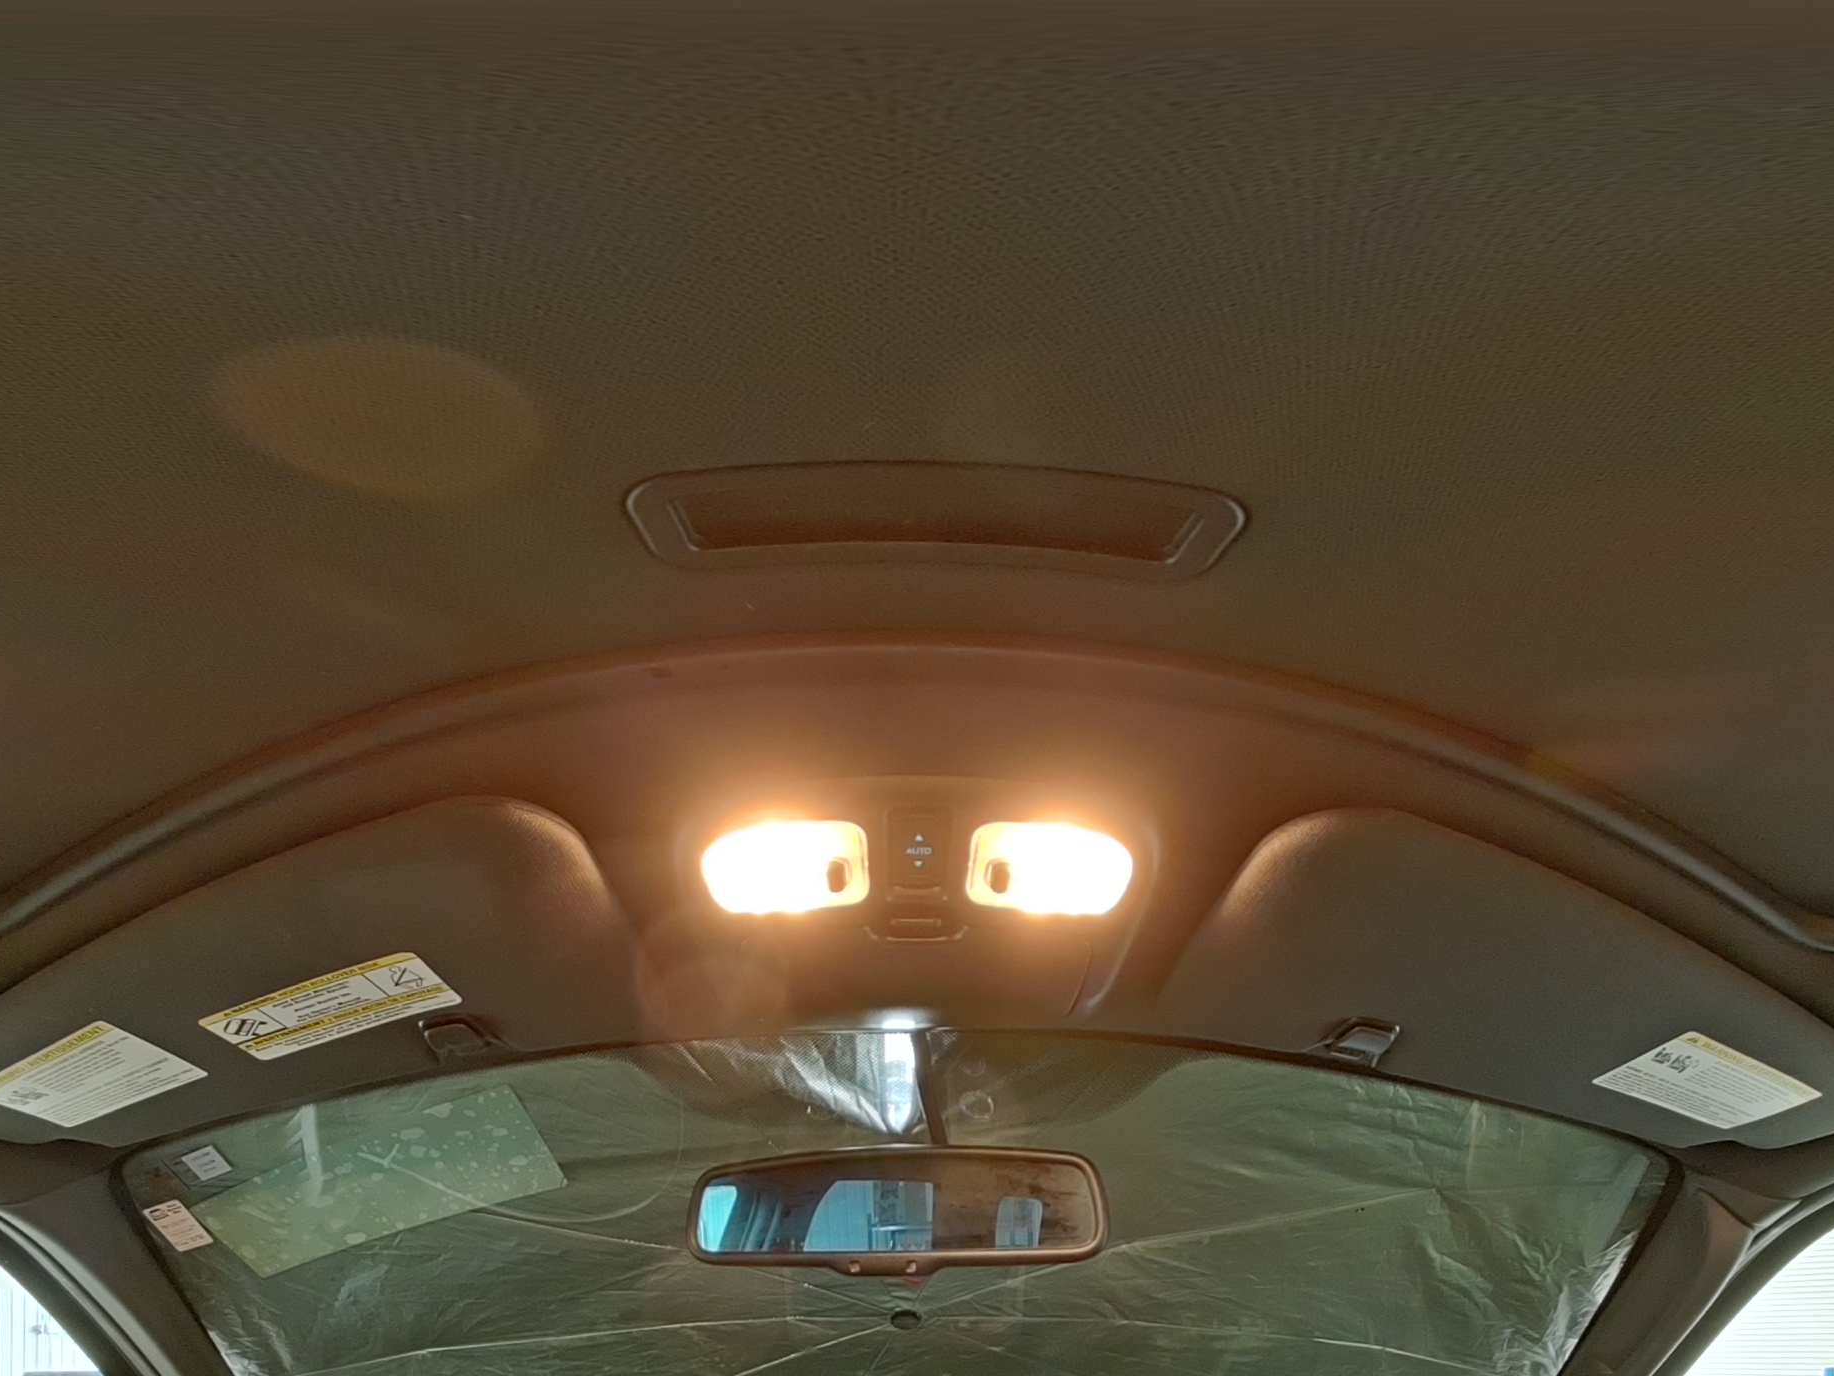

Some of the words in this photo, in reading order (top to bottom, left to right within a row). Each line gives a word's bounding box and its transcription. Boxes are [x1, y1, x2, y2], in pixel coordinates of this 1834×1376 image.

[905, 846, 932, 855] AUTO
[309, 968, 357, 987] ROLLOVER
[27, 1026, 104, 1067] AVERTISSEMENT
[1702, 1042, 1745, 1066] WARNING
